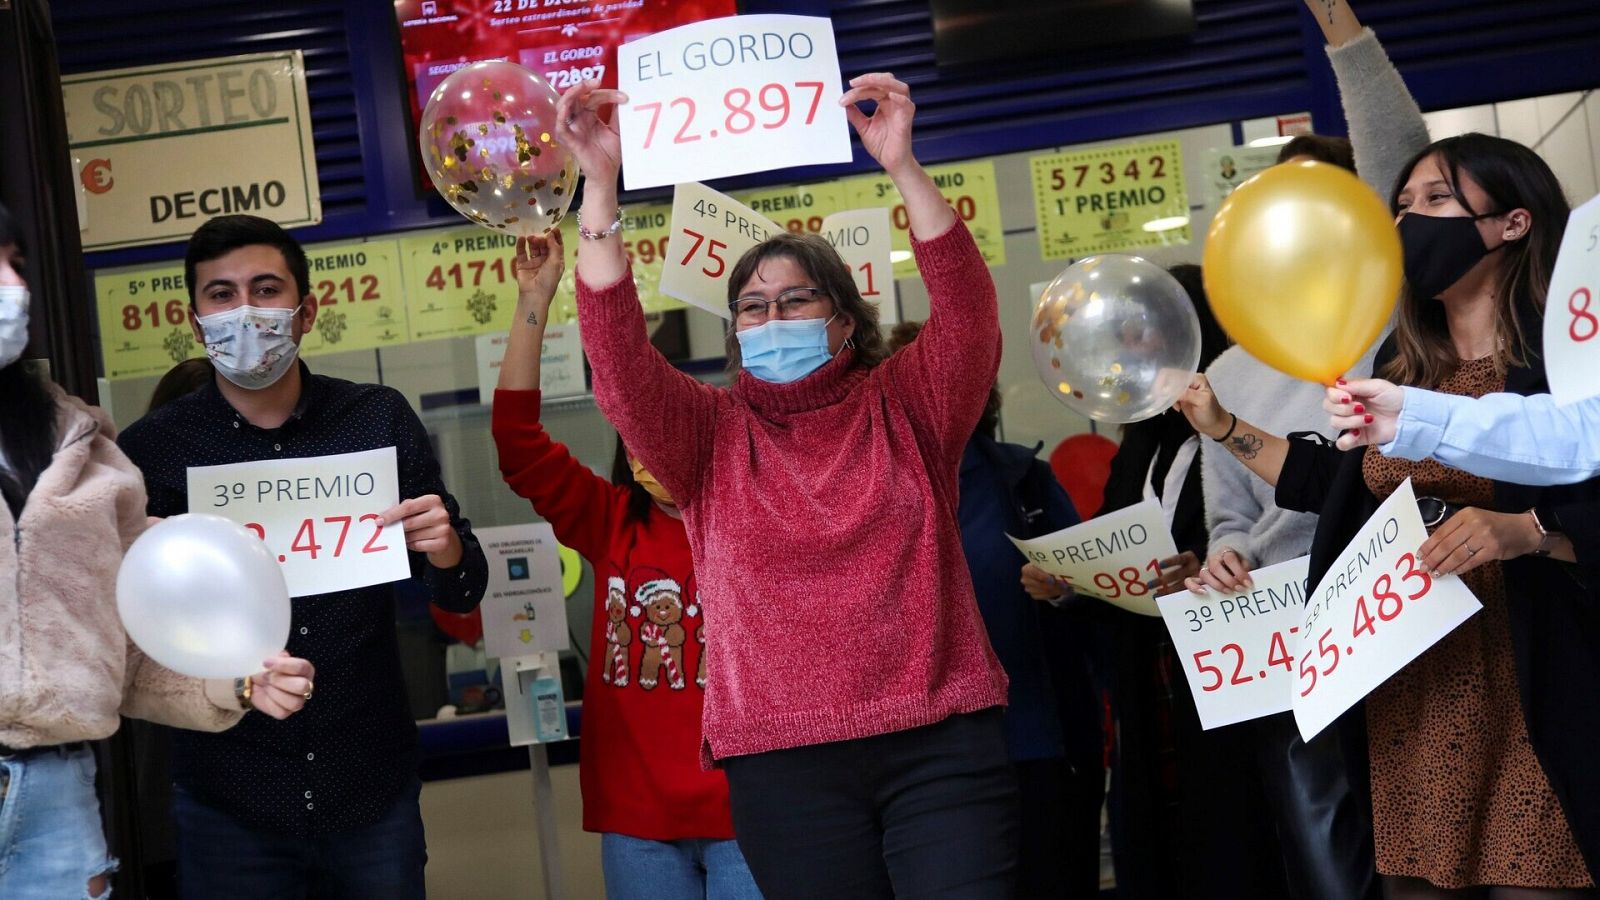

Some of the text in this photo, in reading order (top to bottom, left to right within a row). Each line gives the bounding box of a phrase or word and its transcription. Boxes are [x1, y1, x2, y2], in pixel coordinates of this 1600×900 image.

[494, 1, 512, 13] 22
[543, 46, 603, 64] EL GORDO
[637, 32, 813, 81] EL GORDO
[545, 65, 606, 88] 72897
[92, 67, 277, 136] SORTEO
[633, 81, 825, 149] 72.897
[934, 173, 964, 187] MIO
[149, 180, 286, 223] DECIMO
[751, 193, 814, 212] PREMIO
[1075, 186, 1166, 214] PREMIO
[622, 213, 665, 230] EMIO
[826, 226, 869, 247] MIO
[455, 235, 517, 253] PREMIO
[680, 228, 727, 278] 75
[152, 275, 188, 292] PRE
[309, 274, 381, 306] 212
[122, 299, 186, 331] 816
[1568, 286, 1599, 342] 8
[257, 472, 375, 502] PREMIO
[244, 513, 390, 562] .472
[1052, 523, 1147, 565] PREMIO
[1324, 517, 1399, 611] PREMIO
[1300, 552, 1432, 697] 55.483
[1193, 626, 1299, 692] 52.4
